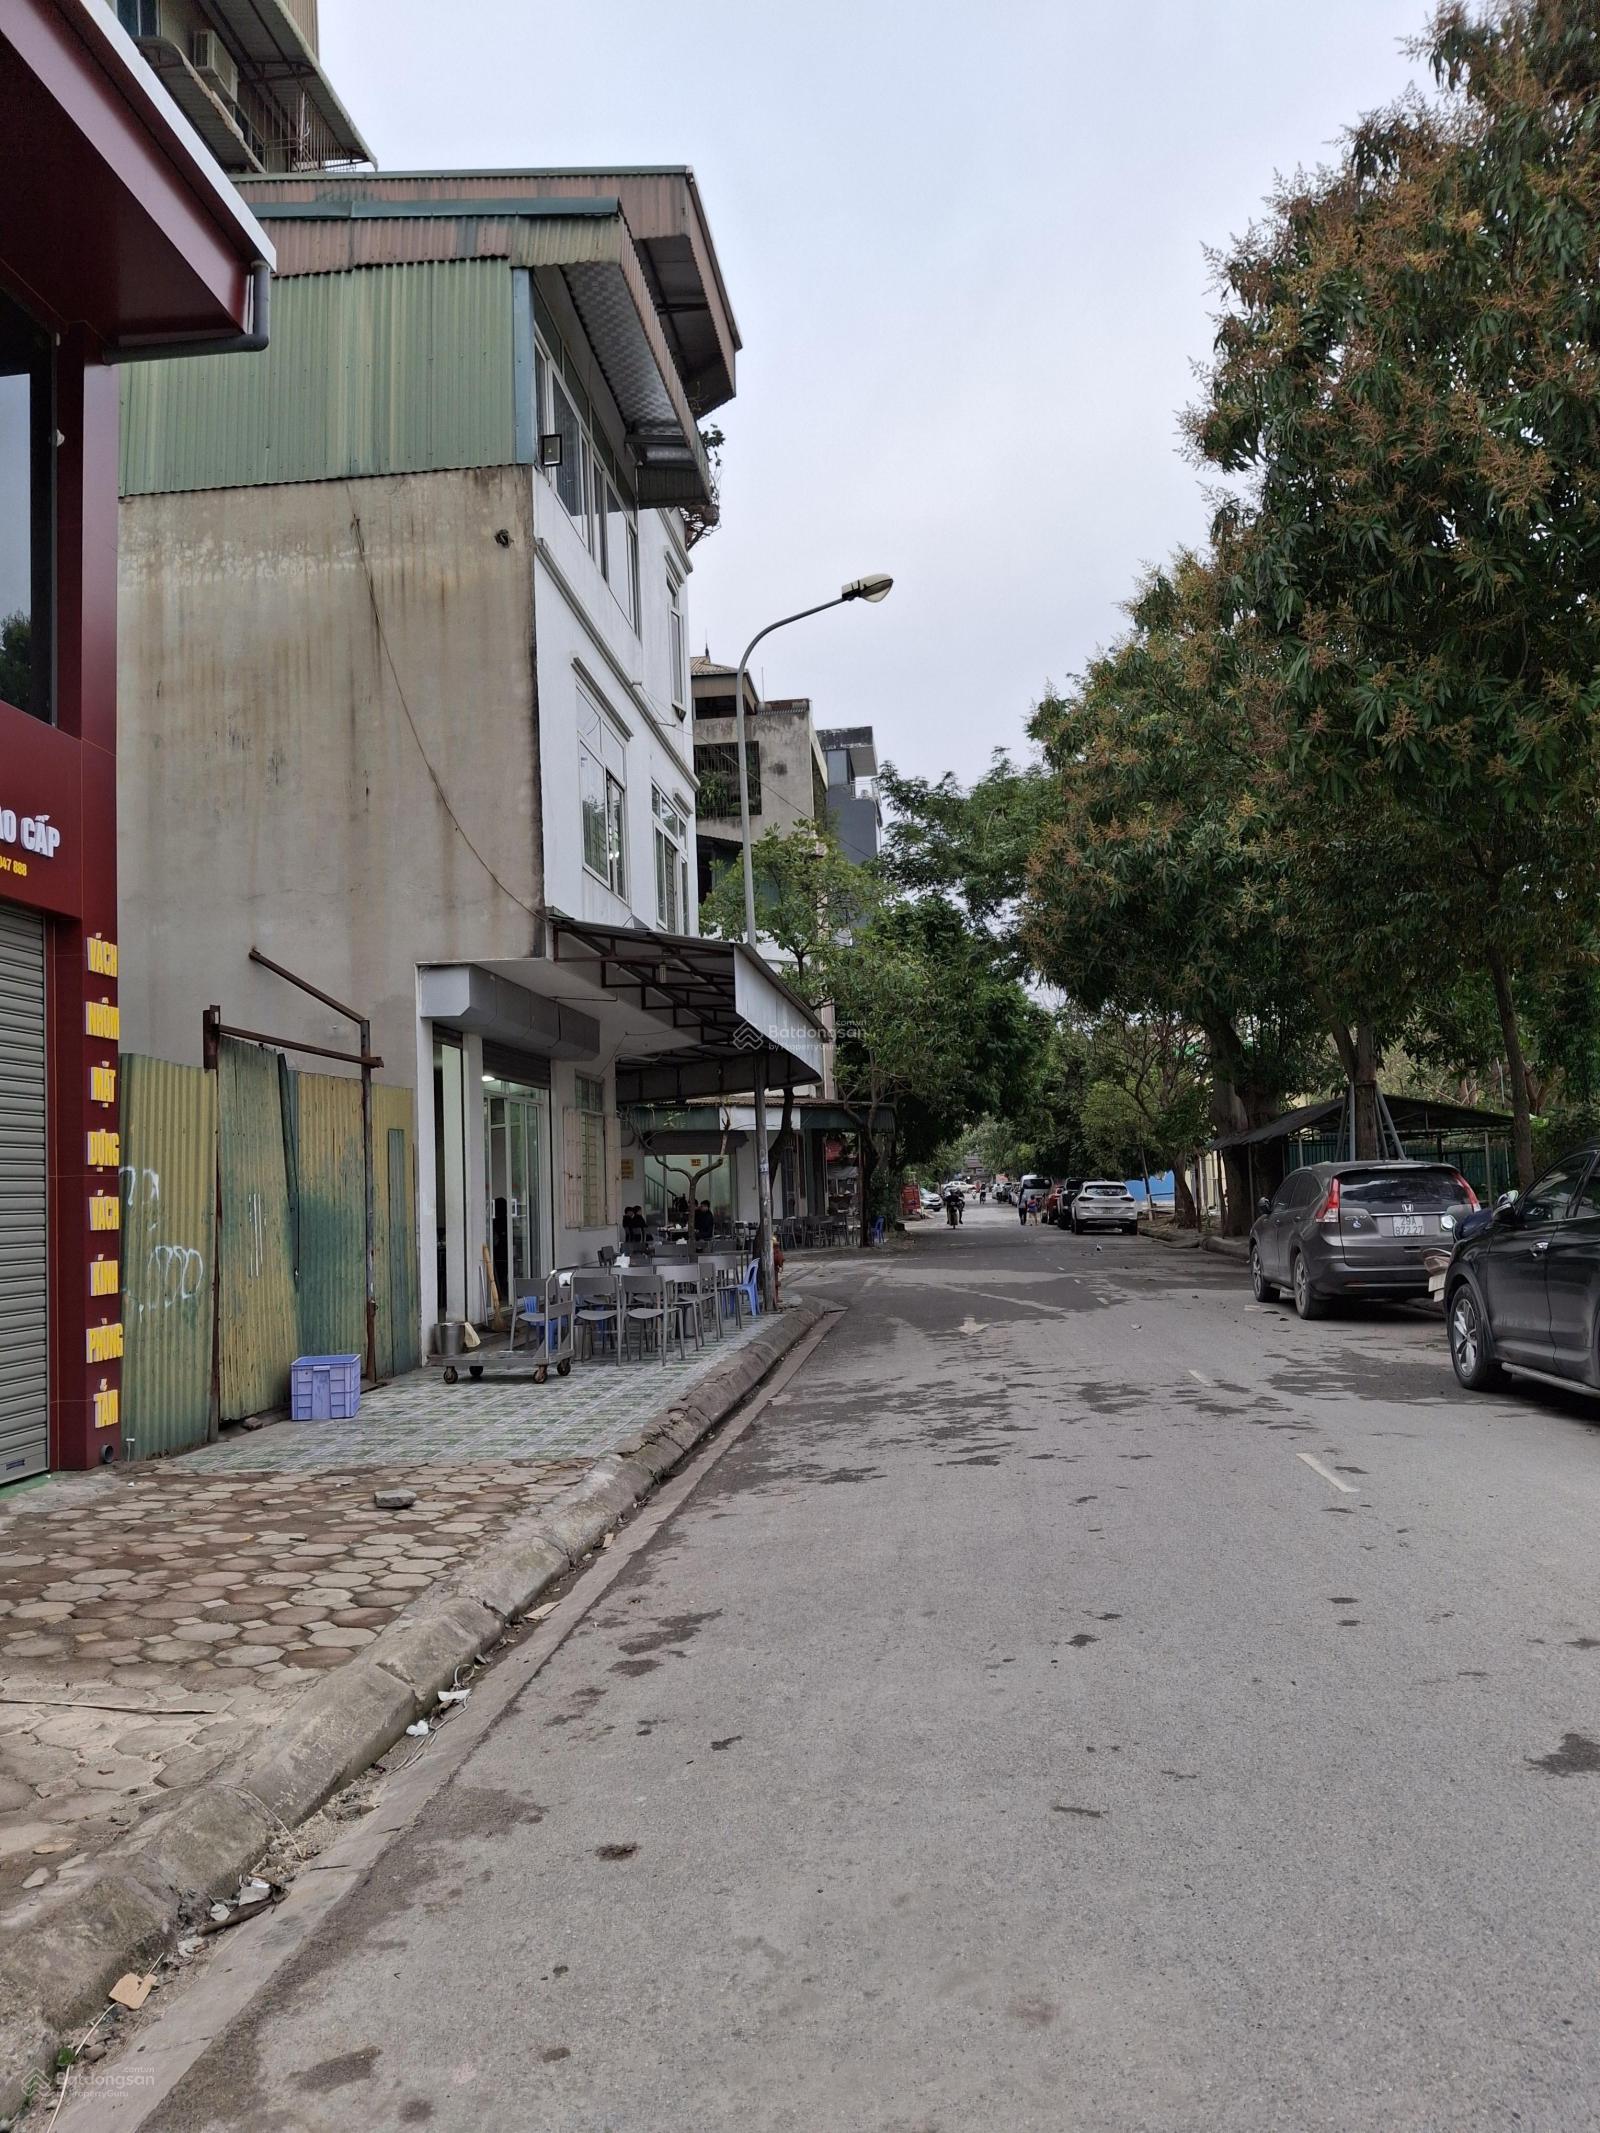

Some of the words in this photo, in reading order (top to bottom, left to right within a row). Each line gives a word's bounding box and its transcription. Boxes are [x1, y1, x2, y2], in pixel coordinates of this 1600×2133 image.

[0, 805, 17, 843] O
[21, 815, 60, 858] CẤP
[87, 932, 118, 977] VÁCH
[85, 997, 120, 1040] NHÔM
[90, 1060, 116, 1108] MẶT
[89, 1189, 120, 1231] VÁCH
[90, 1253, 118, 1296] KÍNH
